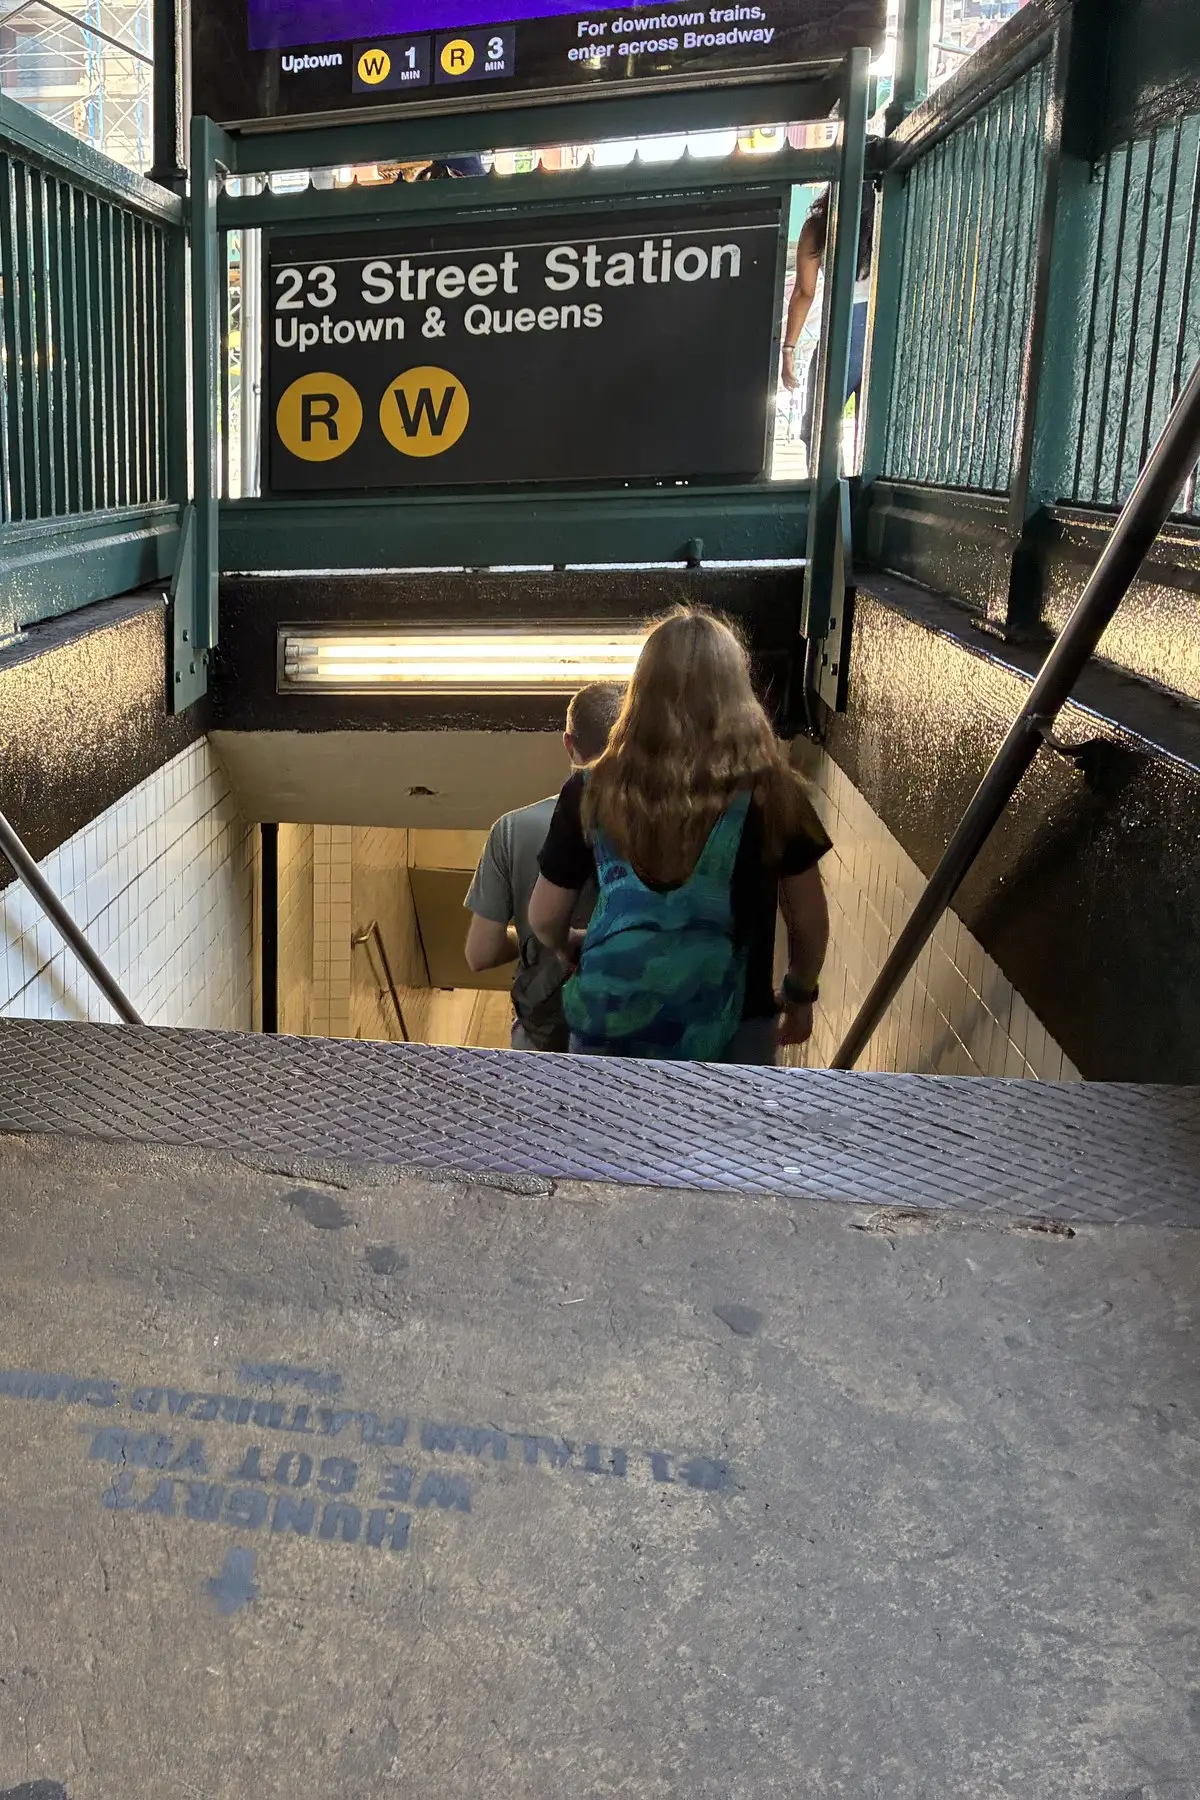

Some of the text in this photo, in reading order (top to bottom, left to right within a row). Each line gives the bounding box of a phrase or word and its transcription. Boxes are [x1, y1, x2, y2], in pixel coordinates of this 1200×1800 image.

[577, 4, 766, 38] For downtown trains,
[404, 46, 416, 69] 1
[487, 36, 504, 59] 3
[567, 27, 775, 62] enter across Broadway
[281, 53, 343, 74] Uptown
[401, 69, 421, 81] MIN
[485, 60, 505, 72] MIN
[275, 239, 741, 309] 23 Street Station
[275, 303, 603, 352] Uptown & Queens
[230, 1446, 357, 1494] GOT
[377, 1464, 471, 1514] WE
[102, 1473, 411, 1550] HUNGRY?
